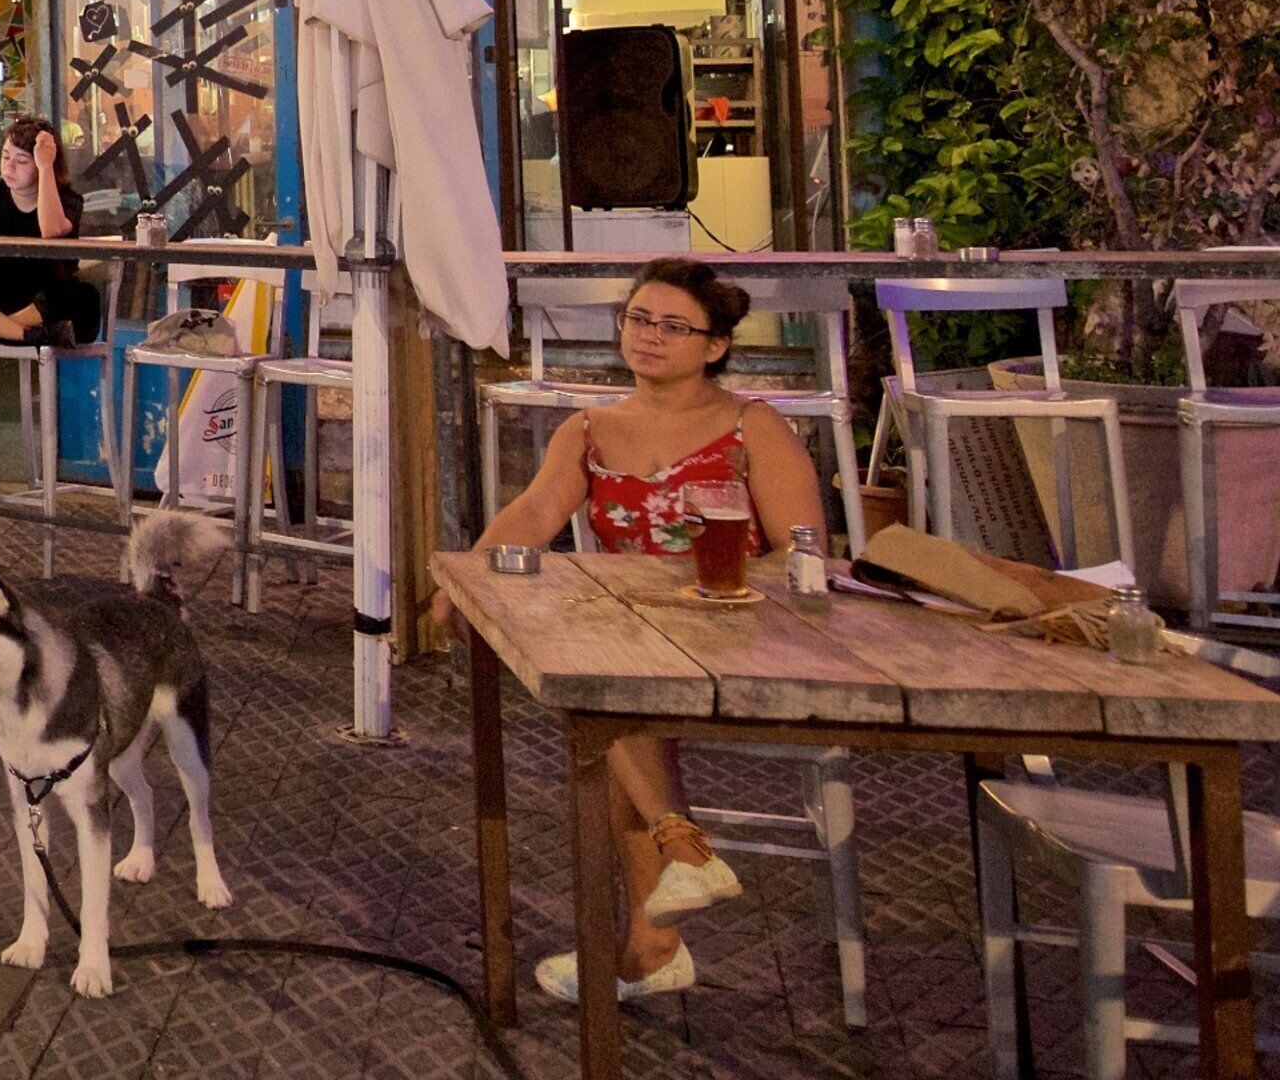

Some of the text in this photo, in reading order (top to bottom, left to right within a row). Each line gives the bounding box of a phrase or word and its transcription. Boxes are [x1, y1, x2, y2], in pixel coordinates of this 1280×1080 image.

[204, 415, 234, 435] San
[977, 435, 987, 452] on
[983, 416, 1009, 471] prohibite
[983, 453, 1006, 501] parking
[1004, 473, 1023, 514] strictly
[1000, 505, 1014, 528] and
